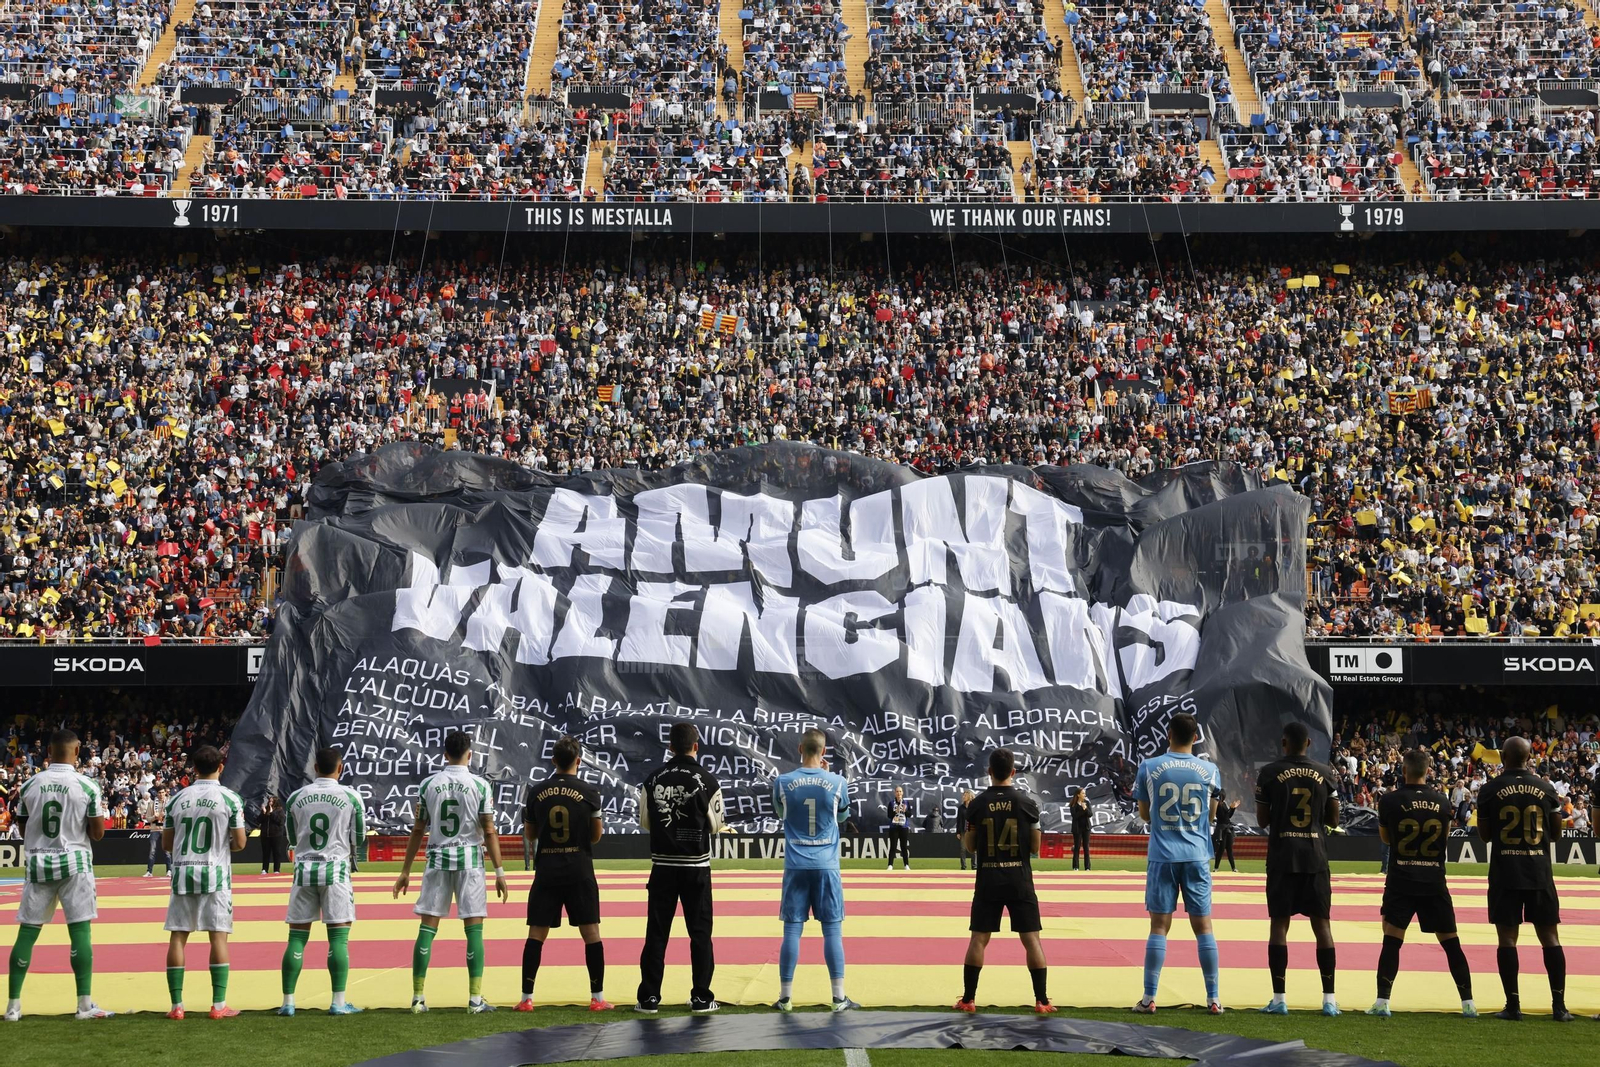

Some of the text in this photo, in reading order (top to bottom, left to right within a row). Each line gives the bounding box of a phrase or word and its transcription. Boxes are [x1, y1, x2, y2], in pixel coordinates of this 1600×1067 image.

[202, 204, 238, 222] 1971
[525, 207, 673, 226] THIS IS MESTALLA
[930, 208, 1111, 227] WE THANK OUR FANS!
[1364, 207, 1404, 226] 1979
[529, 474, 1083, 597] AMUNT
[1334, 654, 1359, 669] TM
[1329, 675, 1403, 684] TM Real Estate Group
[352, 657, 472, 686] ALAQUÀS
[861, 712, 957, 735] ALBERIC
[338, 699, 425, 726] ALZIRA
[344, 676, 471, 714] L'ALCÚDIA
[981, 730, 1090, 752] ALGINET
[1150, 760, 1211, 782] MAMARDASHVILI
[1276, 767, 1325, 785] MOSQUERA
[40, 783, 70, 795] NATAN
[434, 782, 470, 795] BARTRA
[536, 786, 584, 803] HUGO DURO
[787, 776, 834, 792] DOMENECH
[1496, 784, 1545, 801] FOULQUIER
[180, 798, 218, 811] EZ ABDE
[296, 793, 319, 809] VITOR
[320, 793, 348, 810] ROQUE
[1159, 782, 1203, 822] 25
[1290, 787, 1311, 828] 3
[42, 800, 63, 839] 6
[440, 799, 460, 838] 5
[549, 805, 570, 844] 9
[803, 798, 816, 837] 1
[1499, 804, 1544, 846] 20
[180, 816, 213, 855] 10
[309, 812, 330, 851] 8
[981, 817, 1019, 857] 14
[1397, 818, 1442, 857] 22
